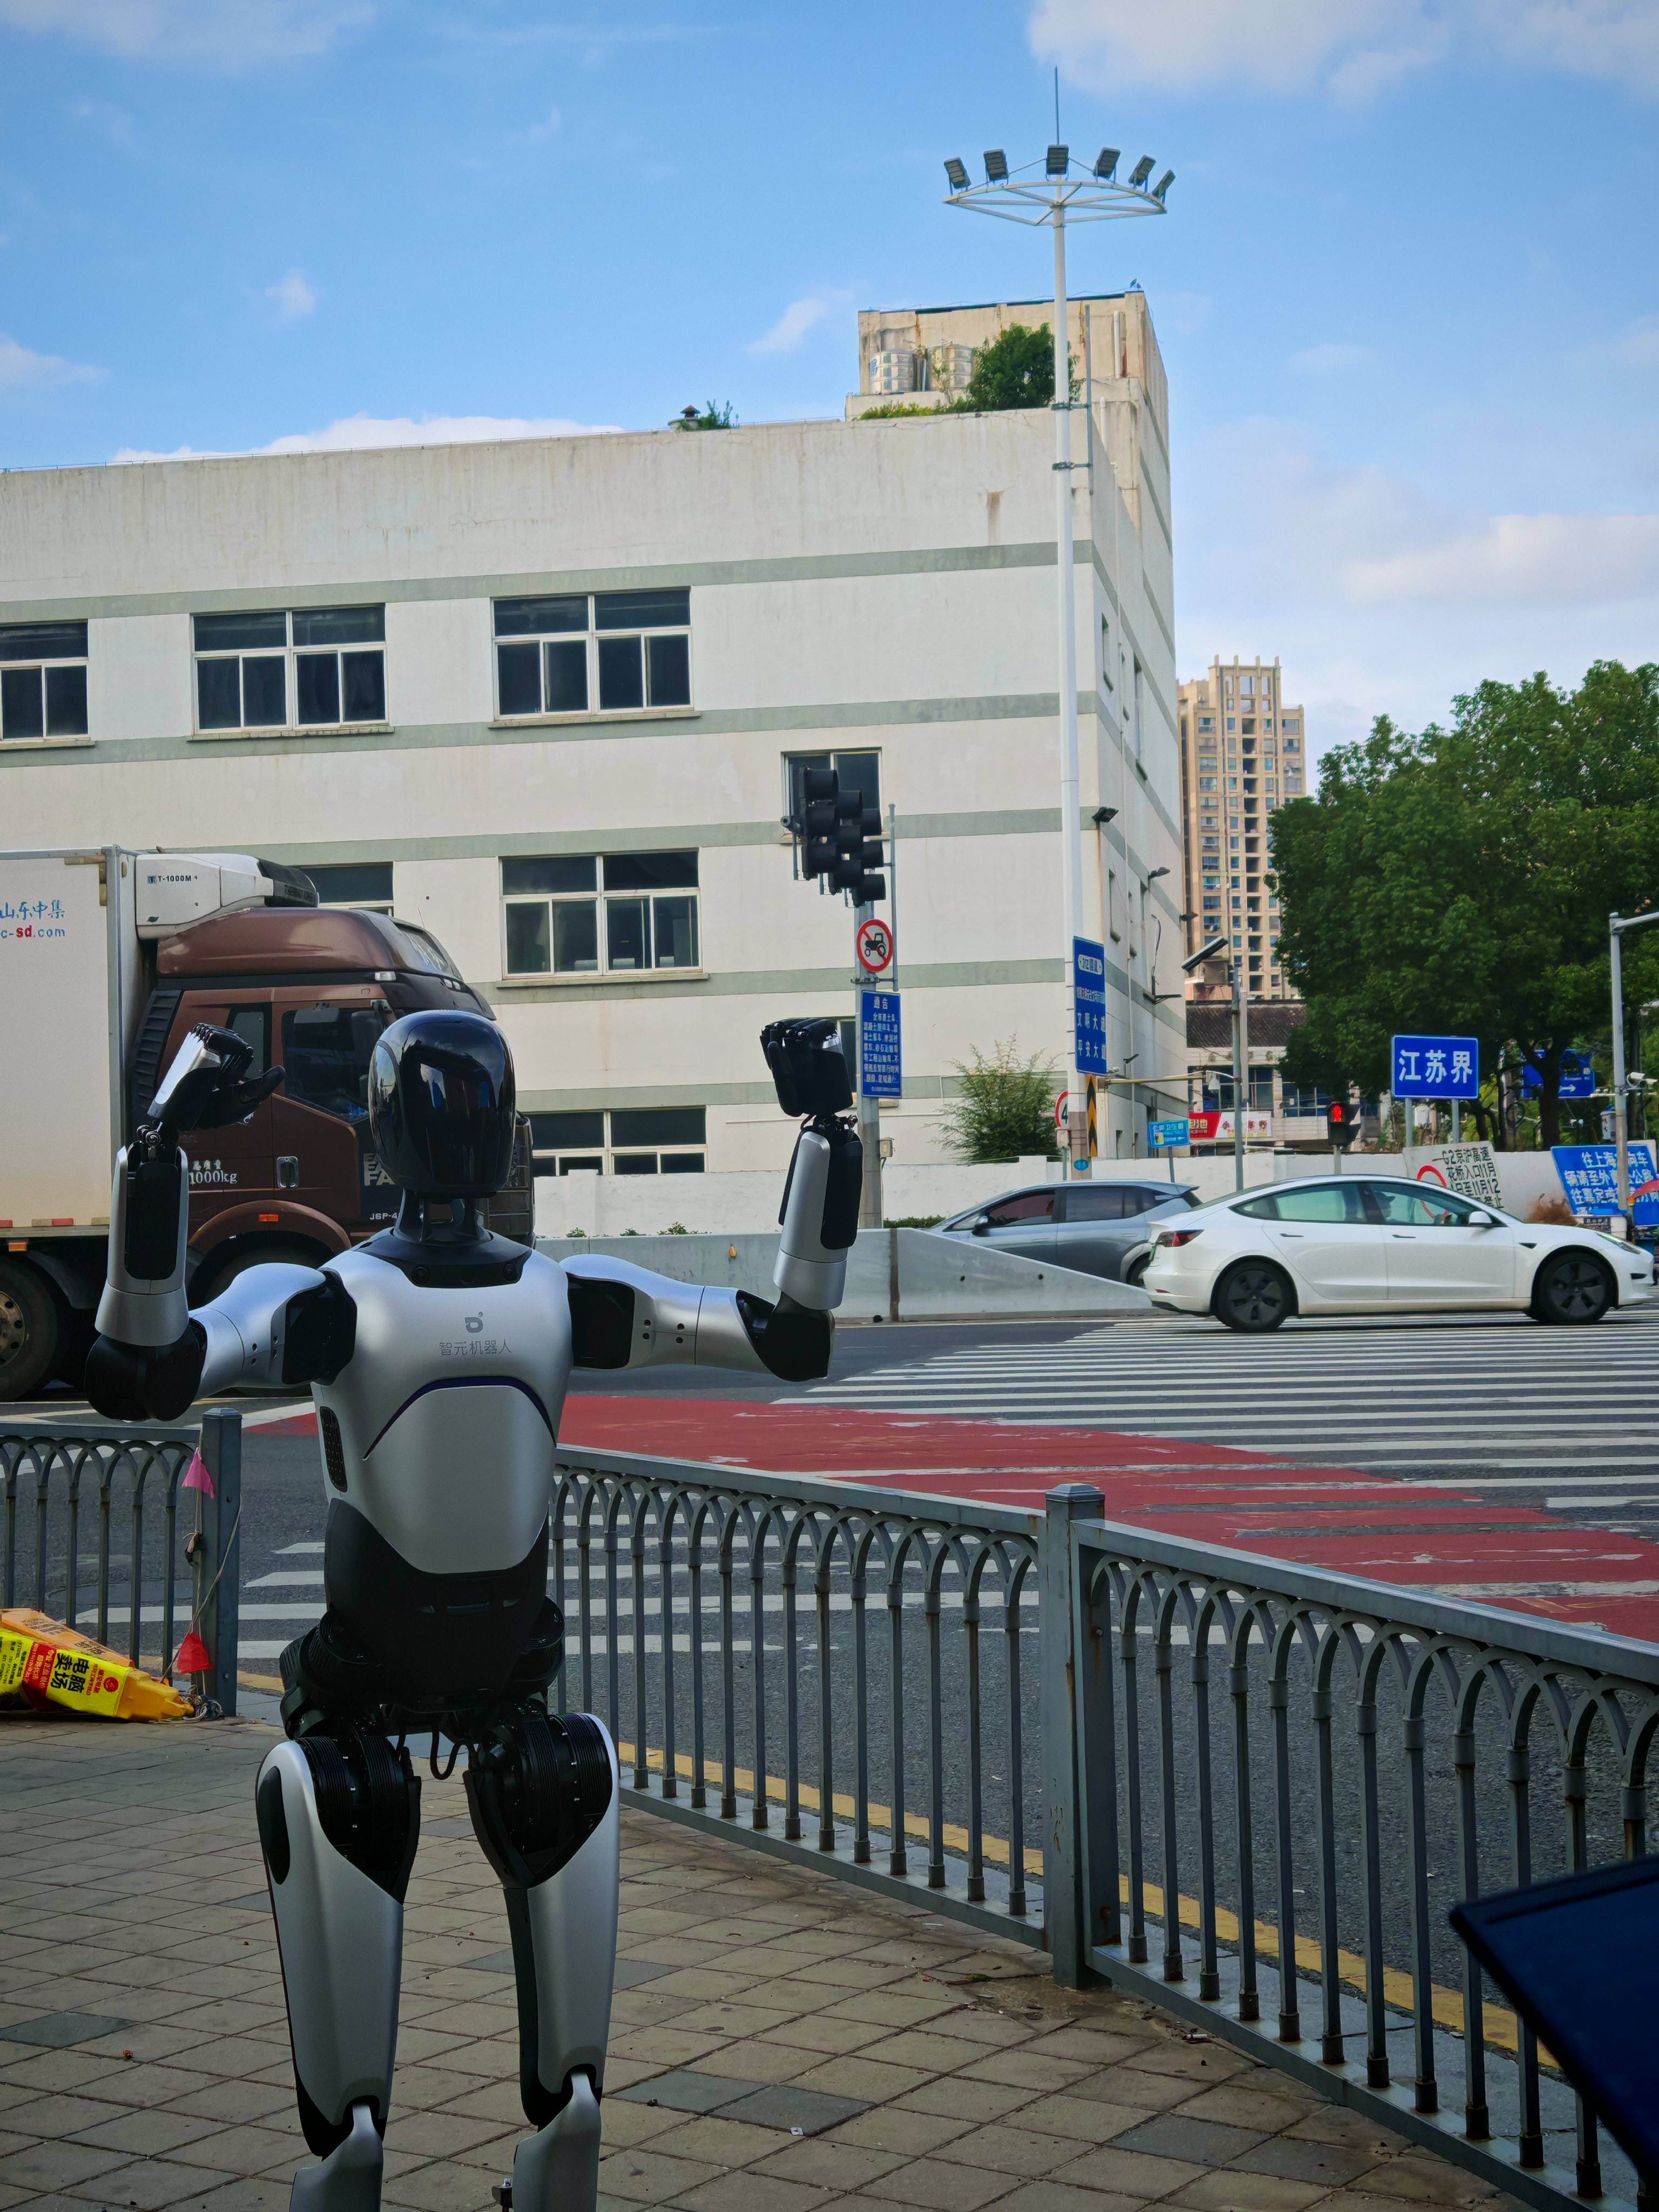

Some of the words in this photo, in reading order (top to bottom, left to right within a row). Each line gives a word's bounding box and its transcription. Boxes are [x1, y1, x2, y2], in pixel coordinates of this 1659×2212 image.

[1077, 1011, 1106, 1033] 文明大道
[1077, 1038, 1107, 1061] 平安大道
[1398, 1048, 1473, 1084] 江苏界
[1442, 1147, 1492, 1165] G2京沪高速
[1582, 1151, 1649, 1168] 往上海向车
[1446, 1162, 1496, 1181] 花桥入口11月
[439, 1338, 512, 1357] 智元机器人
[50, 1652, 73, 1690] 卖场
[67, 1657, 90, 1694] 电脑
